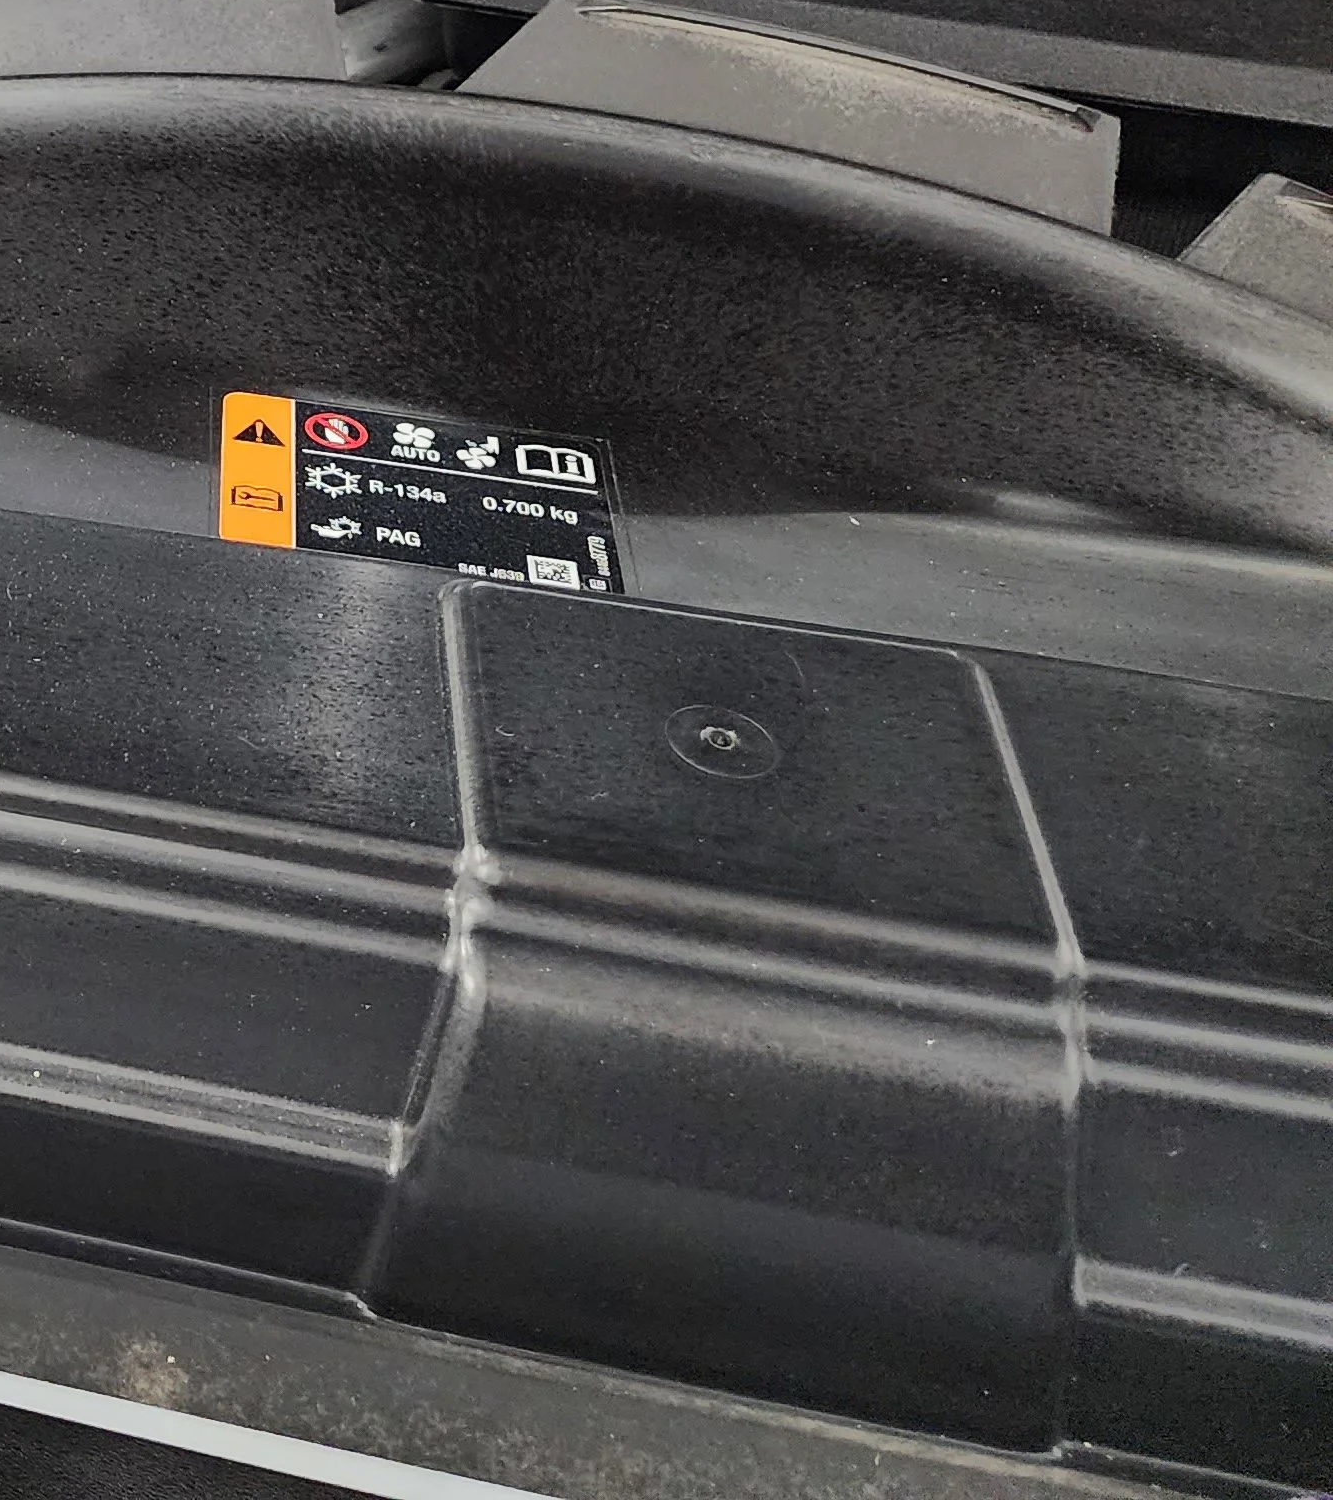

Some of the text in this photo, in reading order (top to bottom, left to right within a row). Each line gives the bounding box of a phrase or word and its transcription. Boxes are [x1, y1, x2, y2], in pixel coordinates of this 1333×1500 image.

[390, 444, 441, 464] AUTO
[368, 478, 579, 527] R-134a 0.700 kg
[376, 525, 422, 549] PAG
[457, 562, 488, 577] SAE
